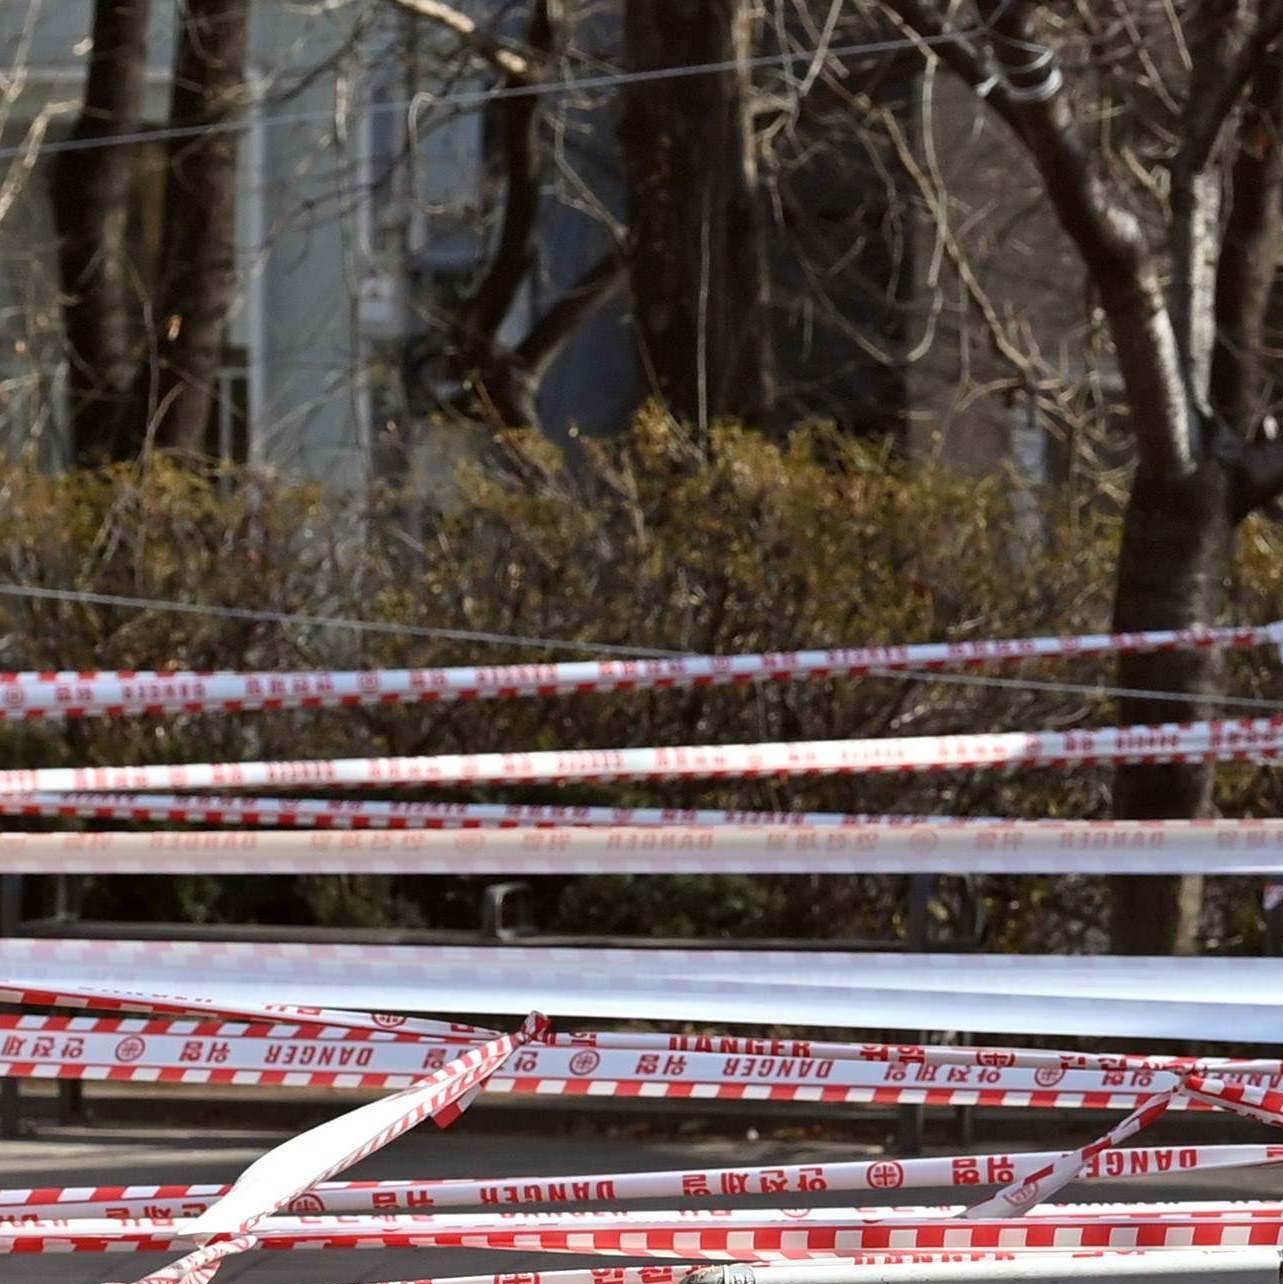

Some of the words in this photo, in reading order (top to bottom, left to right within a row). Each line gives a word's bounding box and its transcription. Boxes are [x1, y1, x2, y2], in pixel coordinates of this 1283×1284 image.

[1, 1035, 84, 1058] 안전제
[179, 1040, 231, 1063] 위험
[264, 1044, 374, 1066] DANGER
[723, 1057, 834, 1079] DANGER
[1085, 1148, 1198, 1178] DANGE
